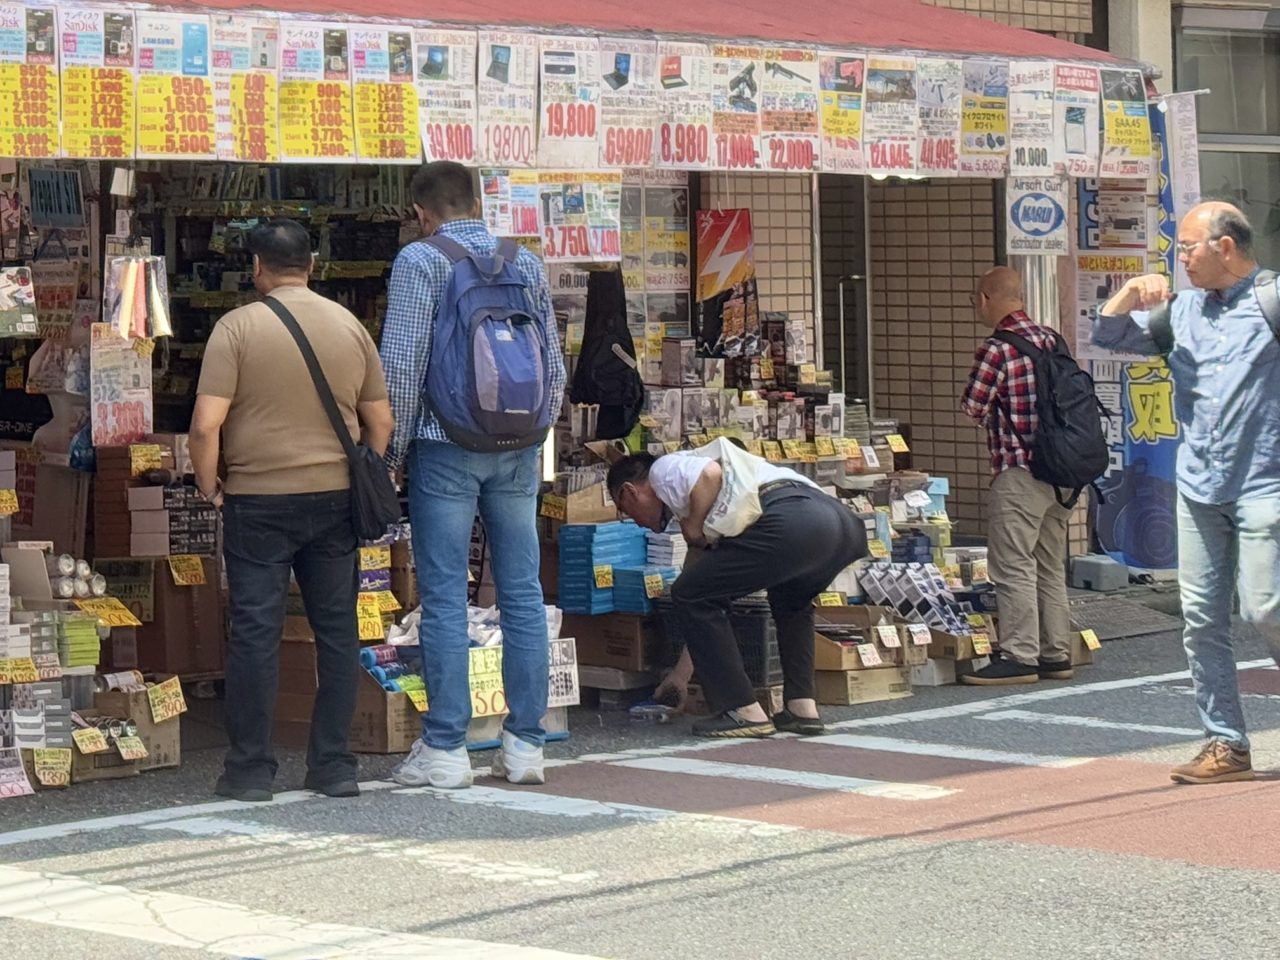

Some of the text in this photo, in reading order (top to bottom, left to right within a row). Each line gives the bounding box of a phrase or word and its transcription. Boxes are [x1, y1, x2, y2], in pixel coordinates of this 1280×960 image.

[171, 77, 205, 96] 950
[163, 96, 208, 114] 1,650
[164, 114, 209, 134] 3,100
[546, 102, 596, 139] 19,800
[974, 121, 994, 130] ホワイト
[165, 134, 211, 153] 5,500
[426, 123, 473, 160] 39,800
[661, 123, 708, 164] 8,980
[1013, 178, 1042, 190] Airsoft
[1021, 205, 1053, 223] MARUI
[545, 225, 591, 258] 3,750
